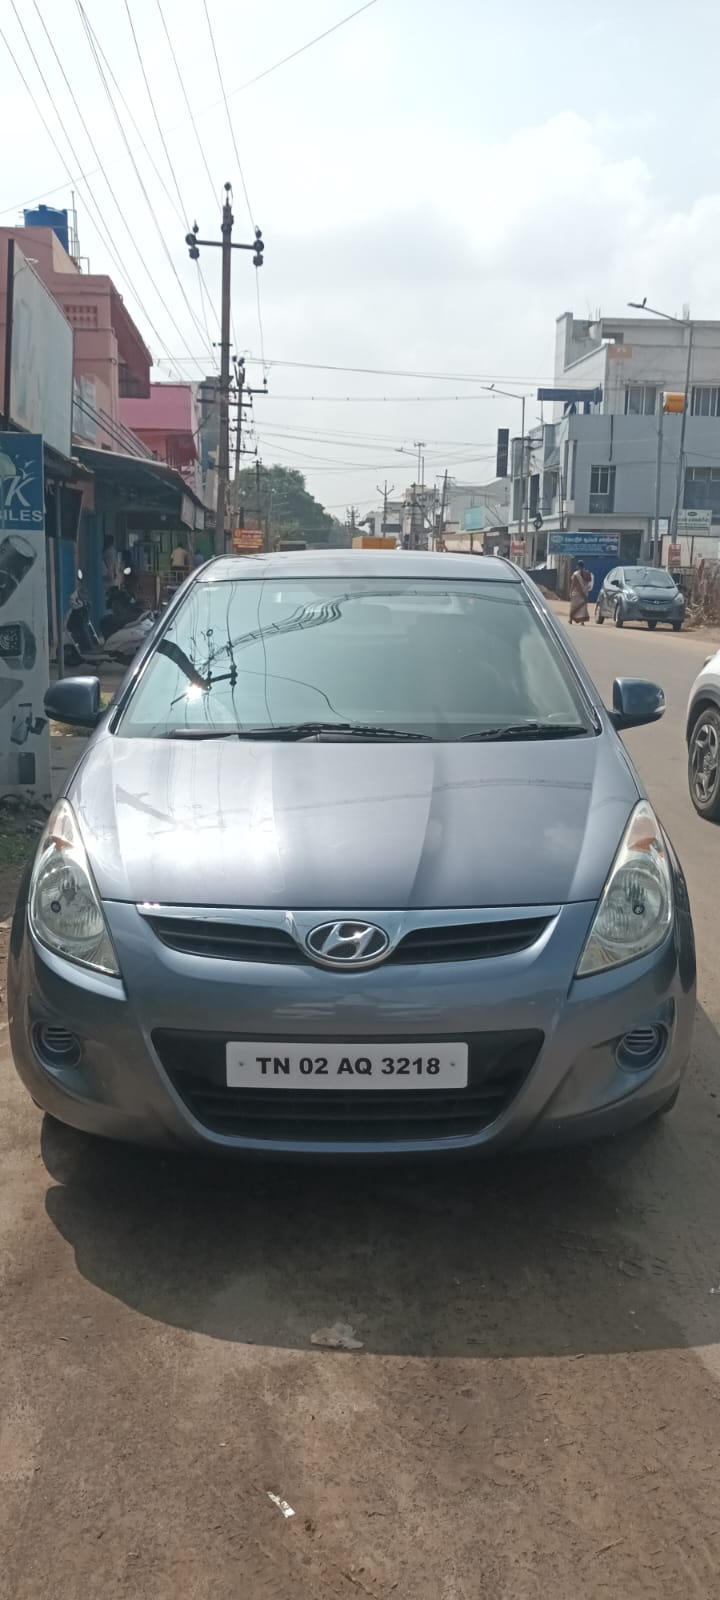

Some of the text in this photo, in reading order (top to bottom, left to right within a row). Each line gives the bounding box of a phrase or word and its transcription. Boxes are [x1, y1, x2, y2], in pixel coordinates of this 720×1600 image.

[255, 1057, 441, 1076] TN 02 AQ 3218
